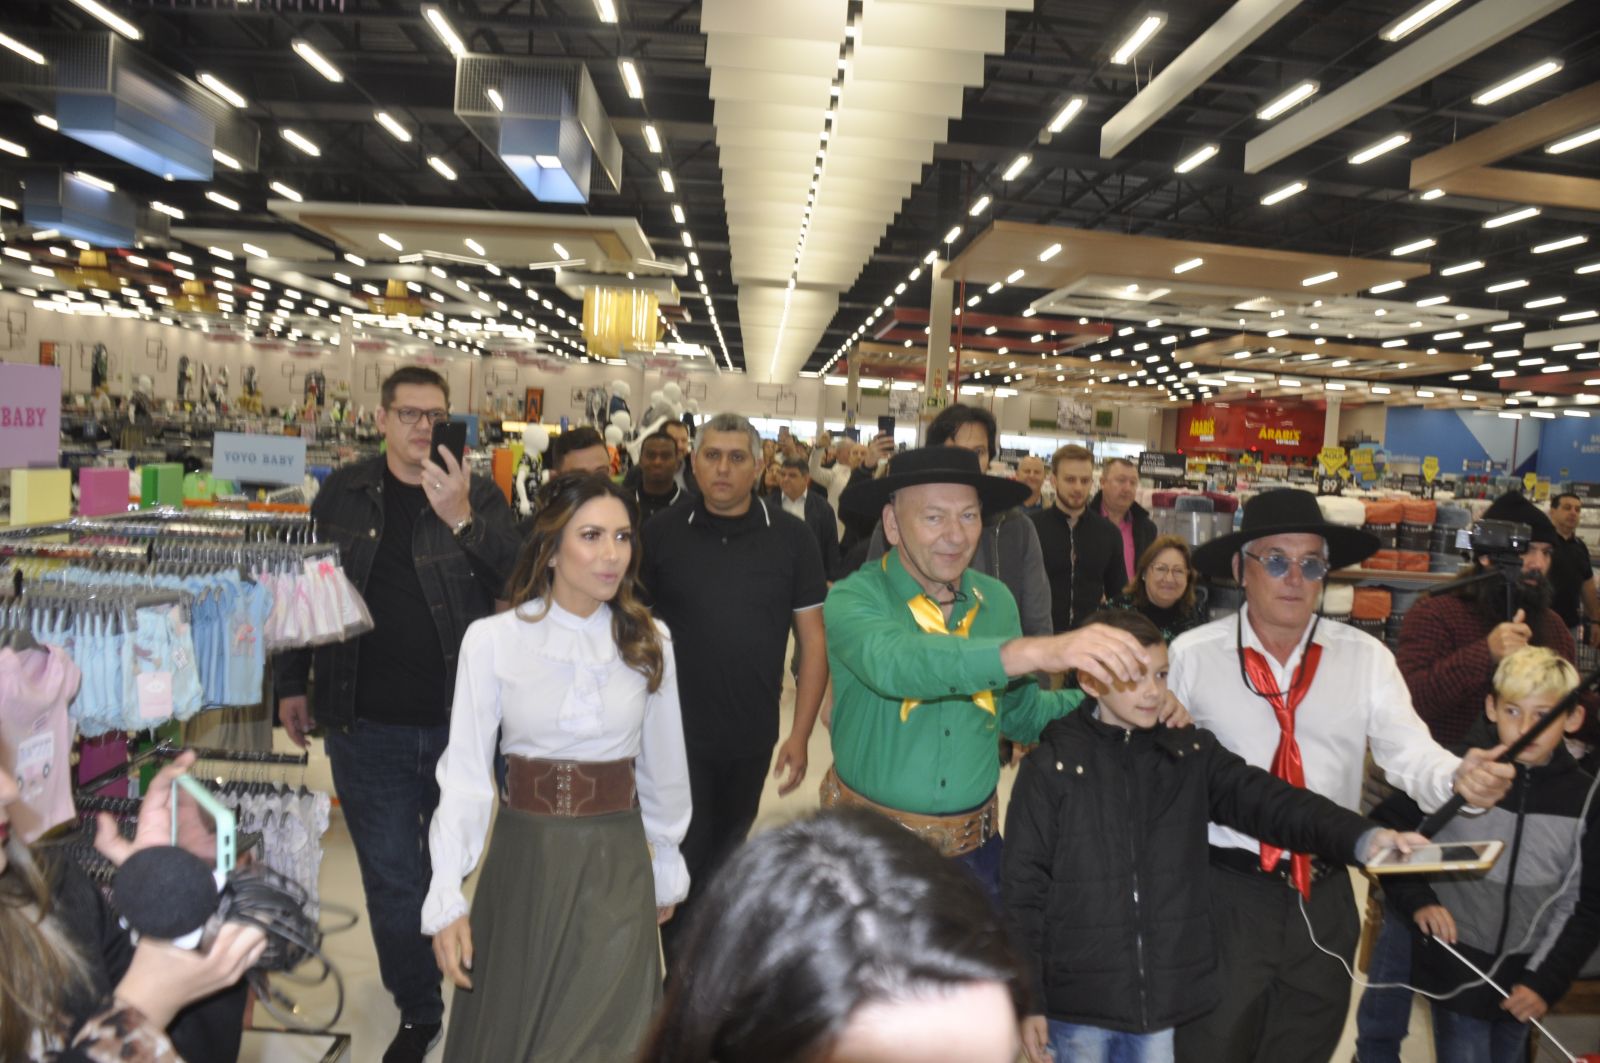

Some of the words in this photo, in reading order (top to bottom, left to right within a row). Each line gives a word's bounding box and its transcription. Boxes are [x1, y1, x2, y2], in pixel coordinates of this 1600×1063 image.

[1, 407, 47, 427] BABY
[223, 451, 257, 464] YOYO
[262, 453, 295, 466] BABY
[1322, 479, 1337, 493] 89
